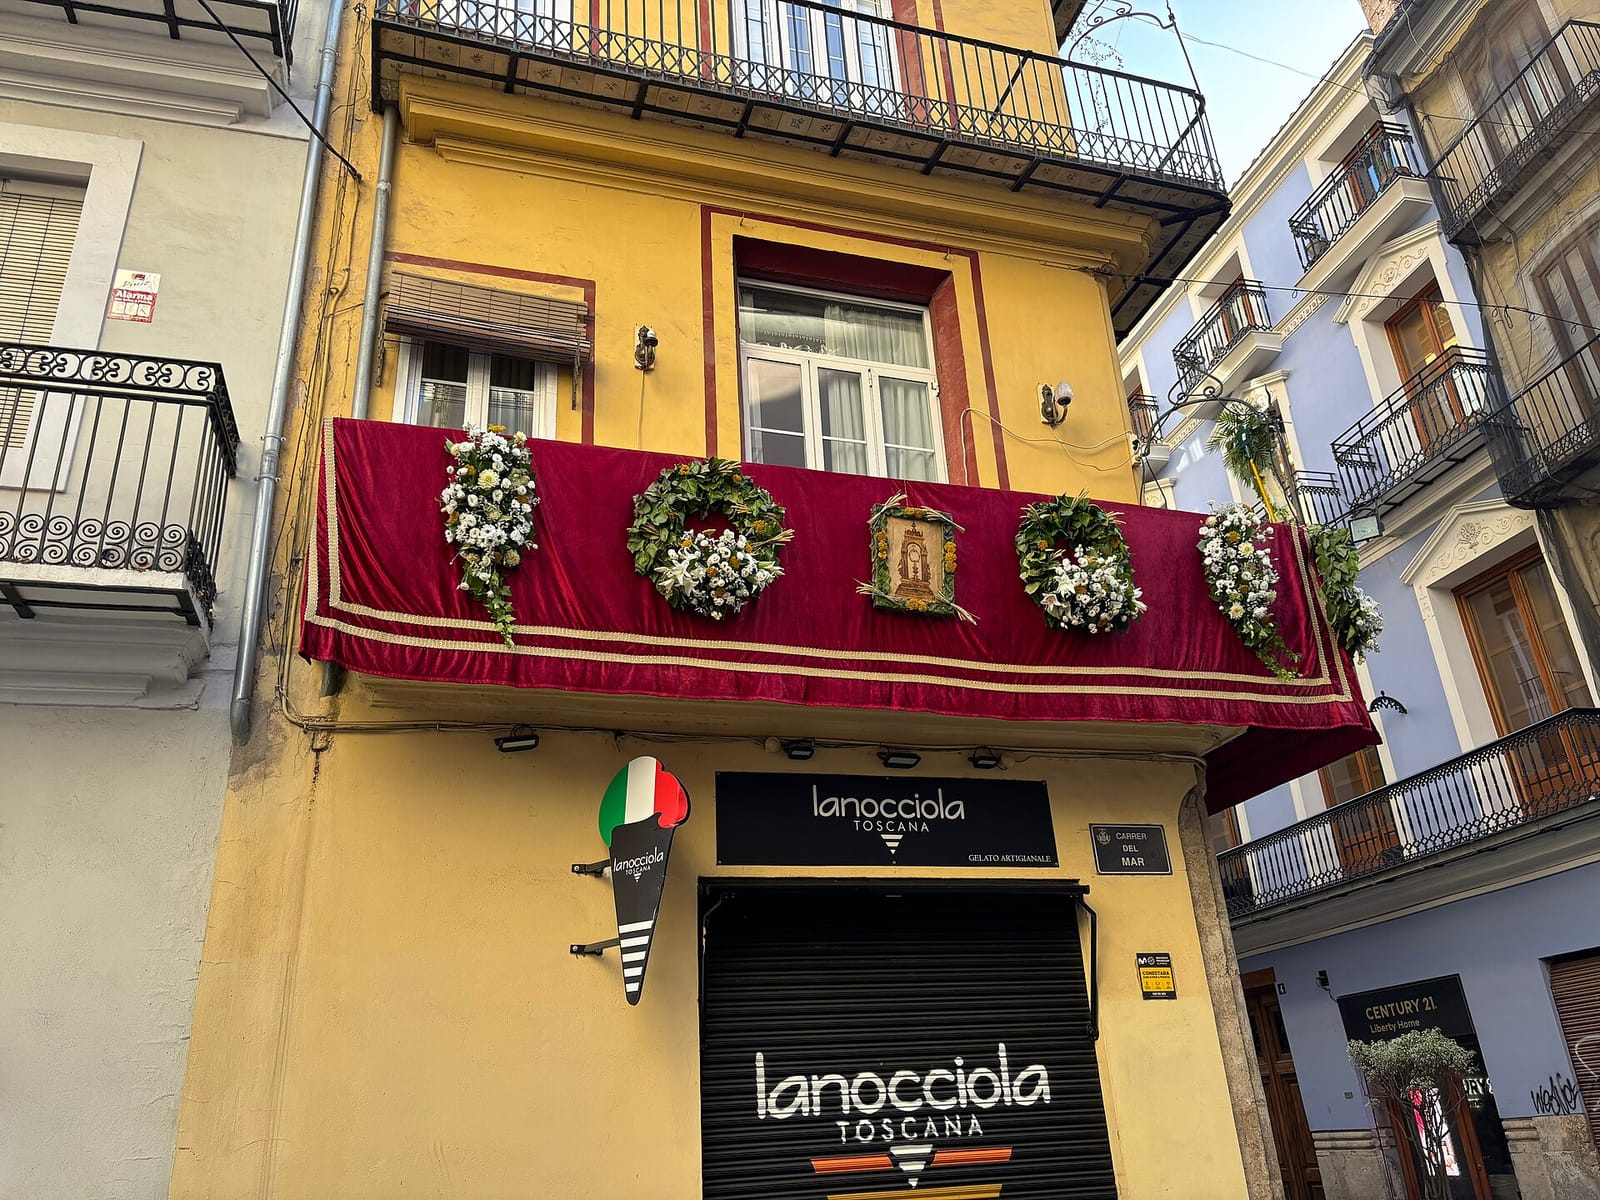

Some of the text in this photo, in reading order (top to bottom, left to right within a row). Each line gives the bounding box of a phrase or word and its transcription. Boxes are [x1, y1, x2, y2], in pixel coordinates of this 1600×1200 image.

[115, 290, 153, 300] Alarma
[812, 784, 966, 820] lanocciola
[853, 819, 930, 833] TOSCANA
[1115, 832, 1148, 841] CARRER
[1122, 844, 1139, 853] DEL
[613, 846, 664, 872] lanocciola
[968, 854, 1052, 863] GELATO ARTIGIANALE
[1121, 857, 1145, 867] MAR
[625, 865, 651, 876] TOSCANA
[1365, 998, 1420, 1020] CENTURY
[1369, 1019, 1421, 1034] Liberty Home
[755, 1042, 1052, 1120] lanocciola
[836, 1113, 984, 1144] TOSCANA
